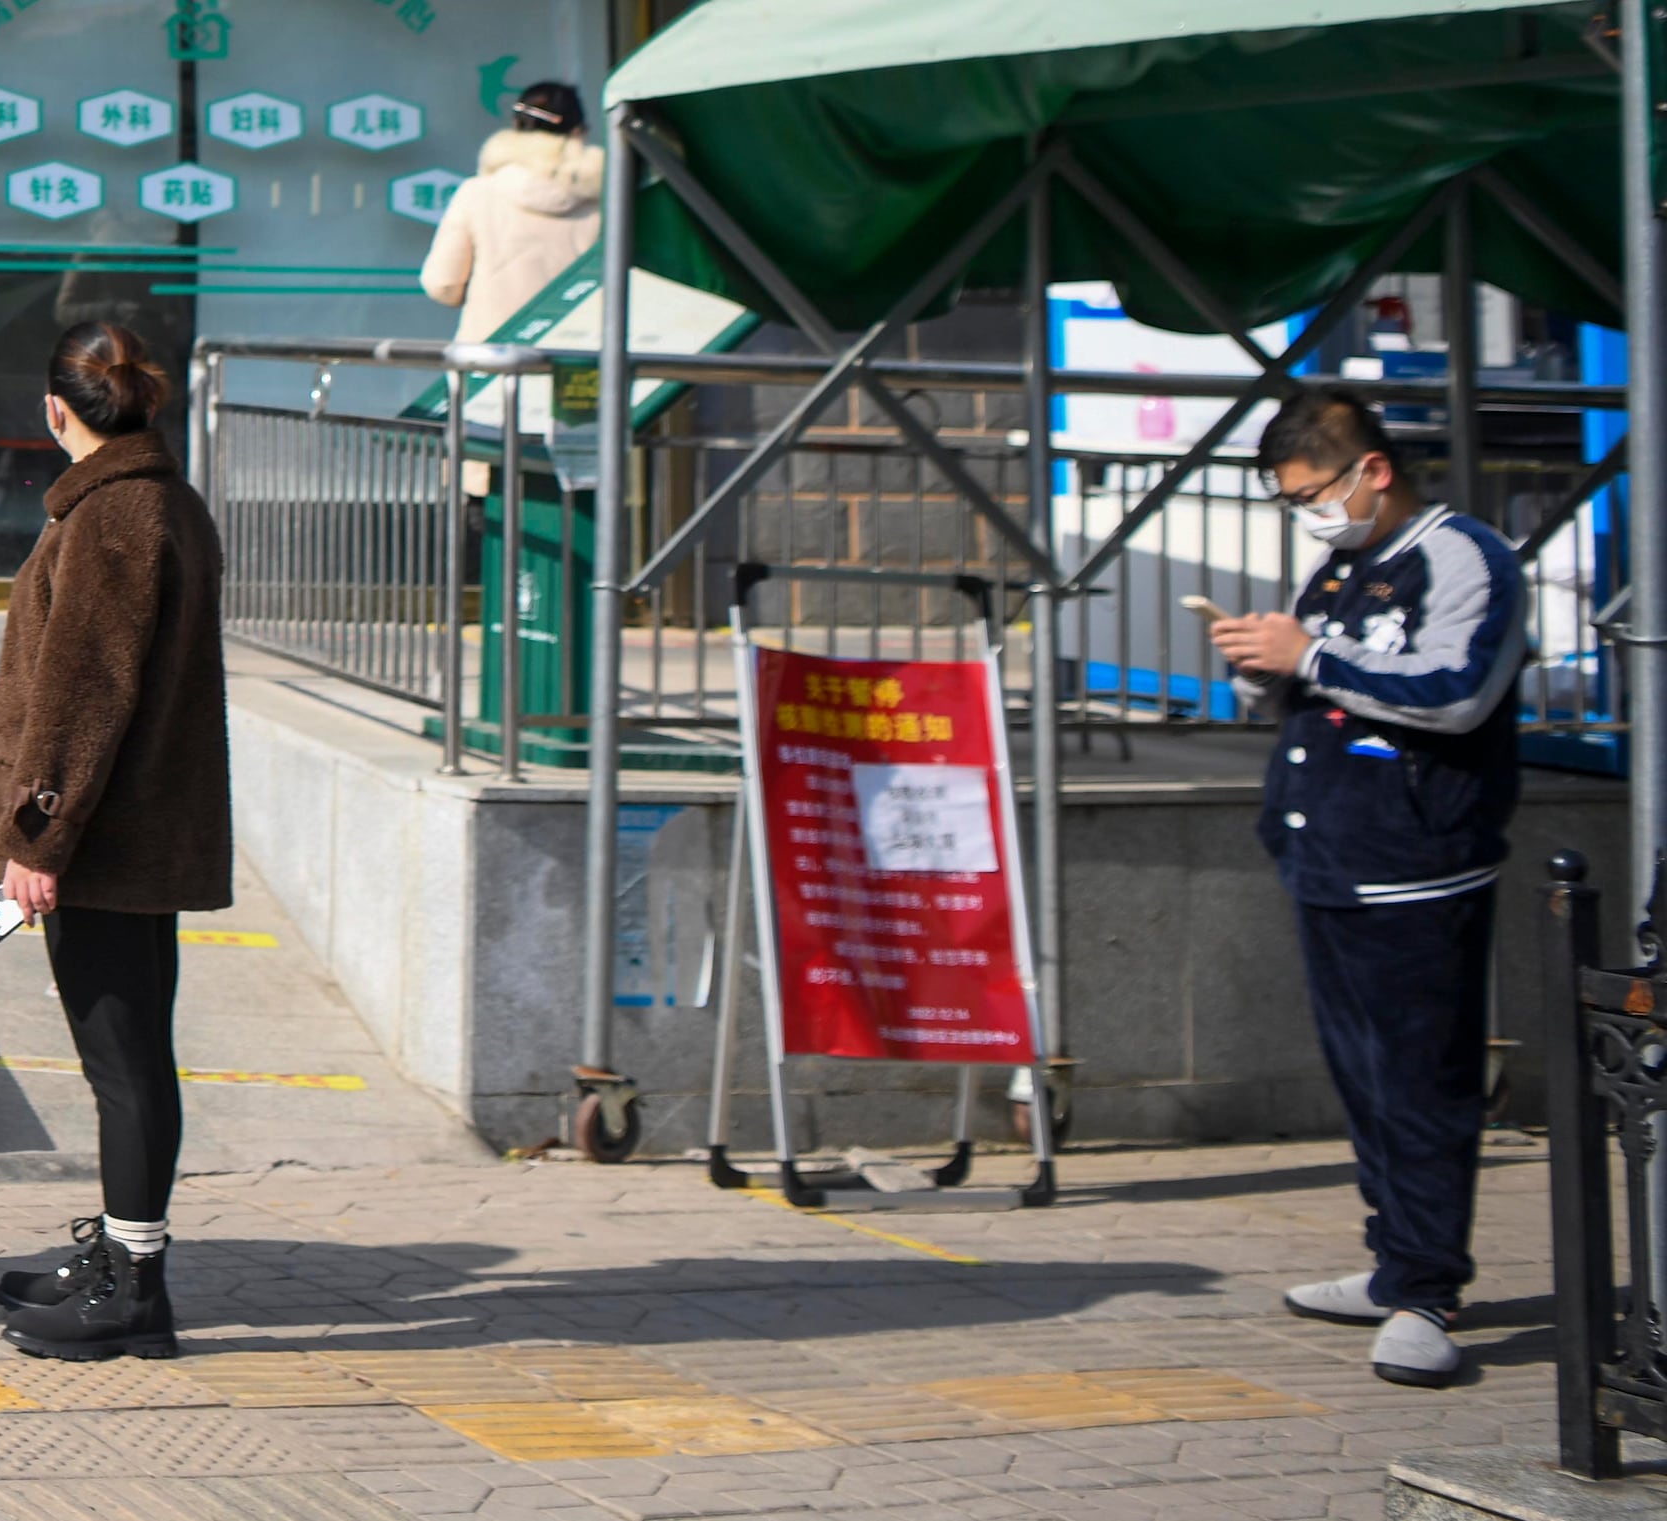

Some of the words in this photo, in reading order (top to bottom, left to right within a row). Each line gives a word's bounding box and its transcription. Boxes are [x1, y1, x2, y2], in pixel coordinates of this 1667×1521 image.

[98, 102, 152, 132] 外科
[228, 105, 282, 135] 妇科
[349, 107, 403, 136] 儿科
[28, 176, 82, 206] 针灸
[160, 179, 215, 208] 药贴
